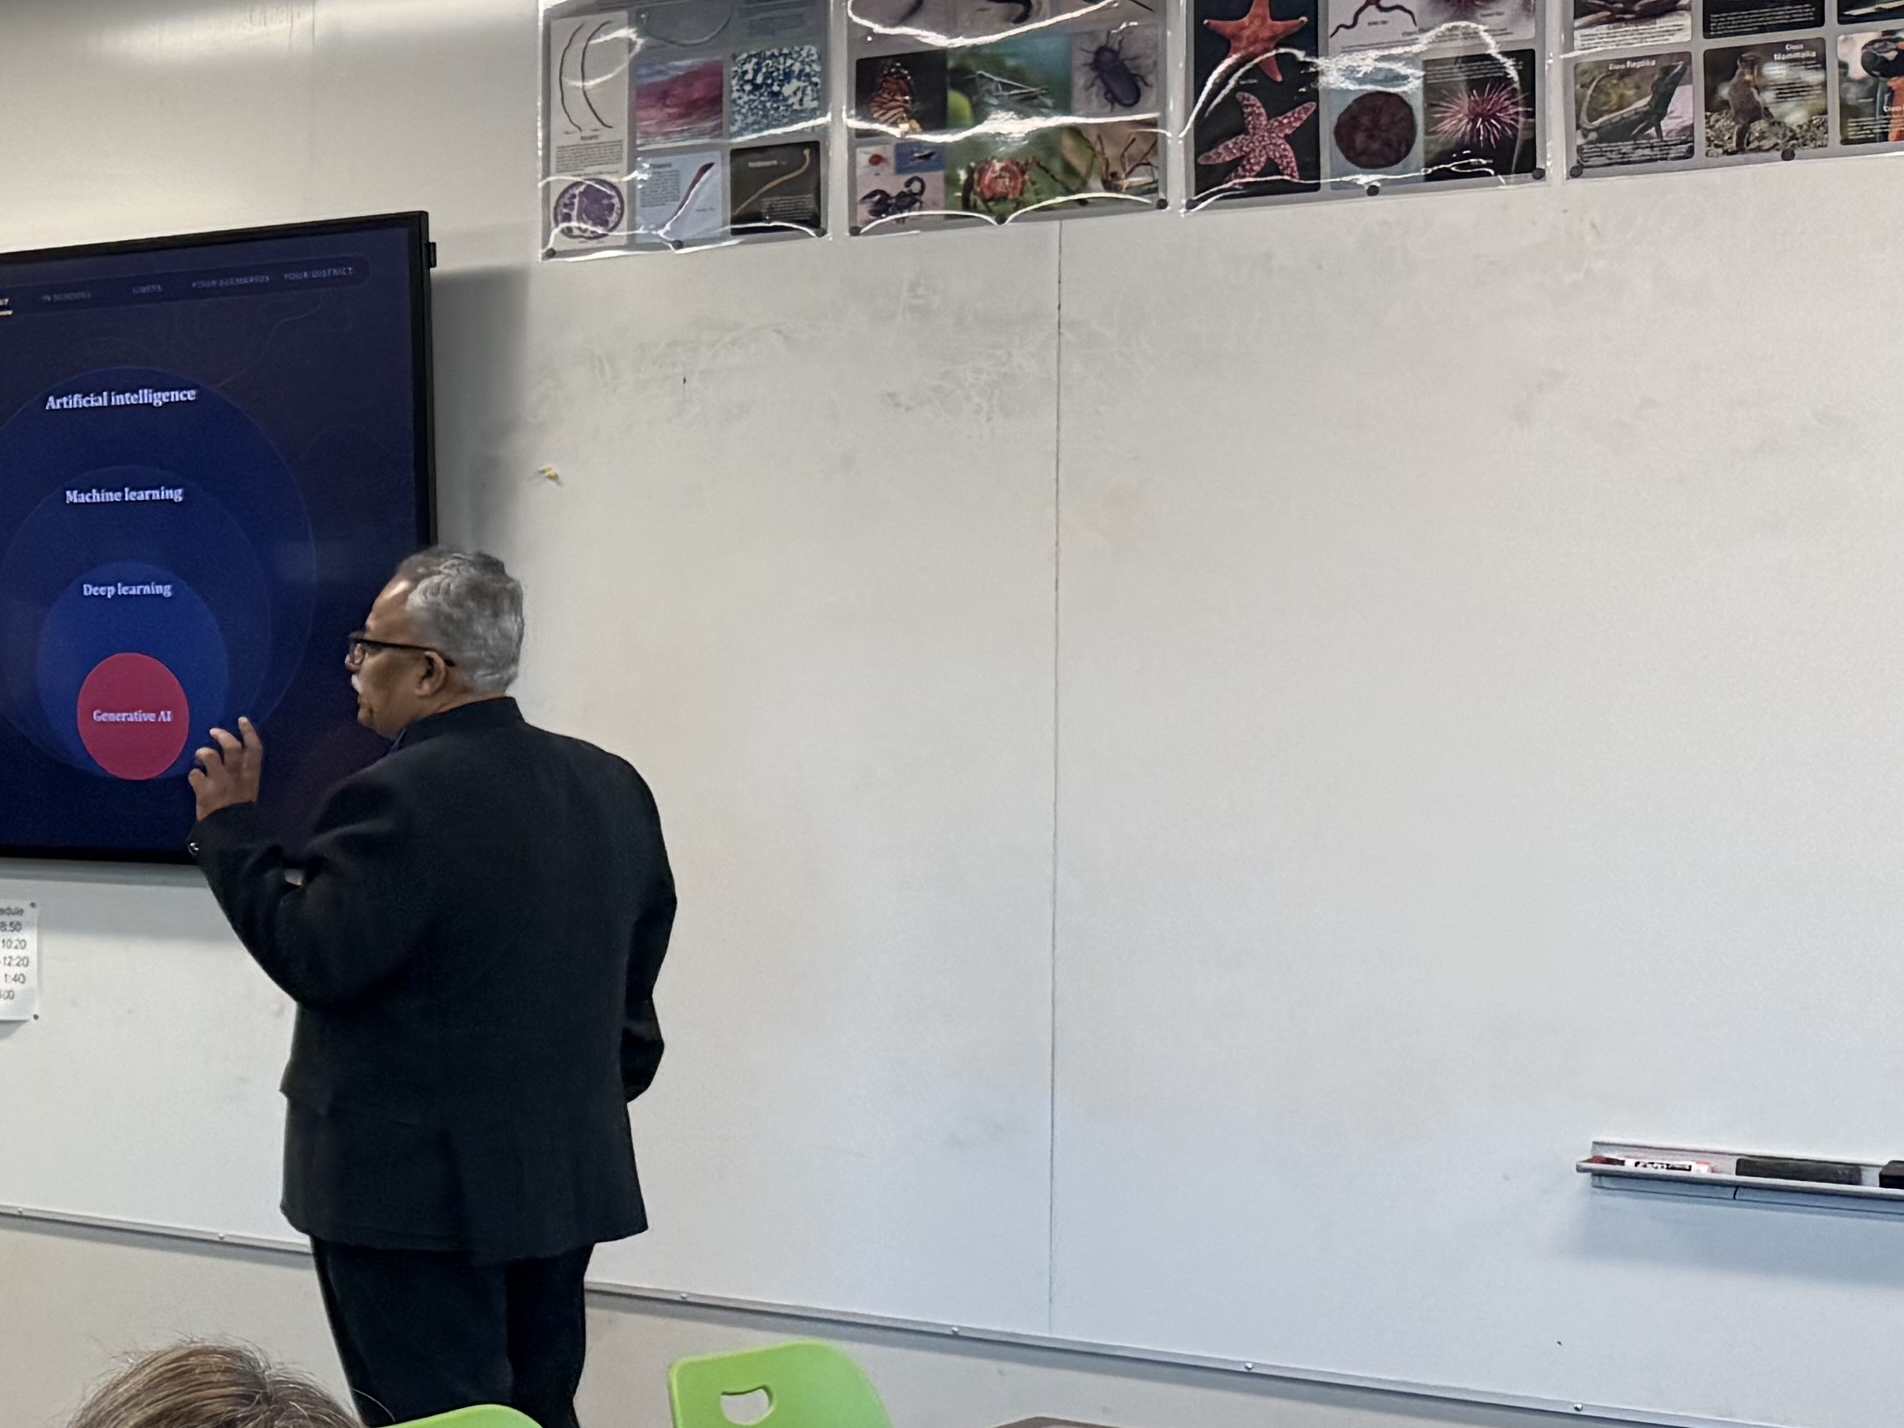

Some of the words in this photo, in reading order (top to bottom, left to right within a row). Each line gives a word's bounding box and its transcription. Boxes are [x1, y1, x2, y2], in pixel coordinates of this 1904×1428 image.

[46, 391, 108, 410] Artificial
[111, 388, 196, 407] intelligence
[66, 488, 122, 504] Machine
[125, 486, 183, 503] learning
[83, 584, 115, 599] Deep
[118, 582, 172, 598] learning
[93, 710, 156, 722] Generative
[158, 710, 171, 722] AI
[0, 920, 22, 932] 8:50
[2, 938, 27, 950] 10:20
[4, 955, 29, 968] 12:20
[5, 972, 26, 985] 1:40
